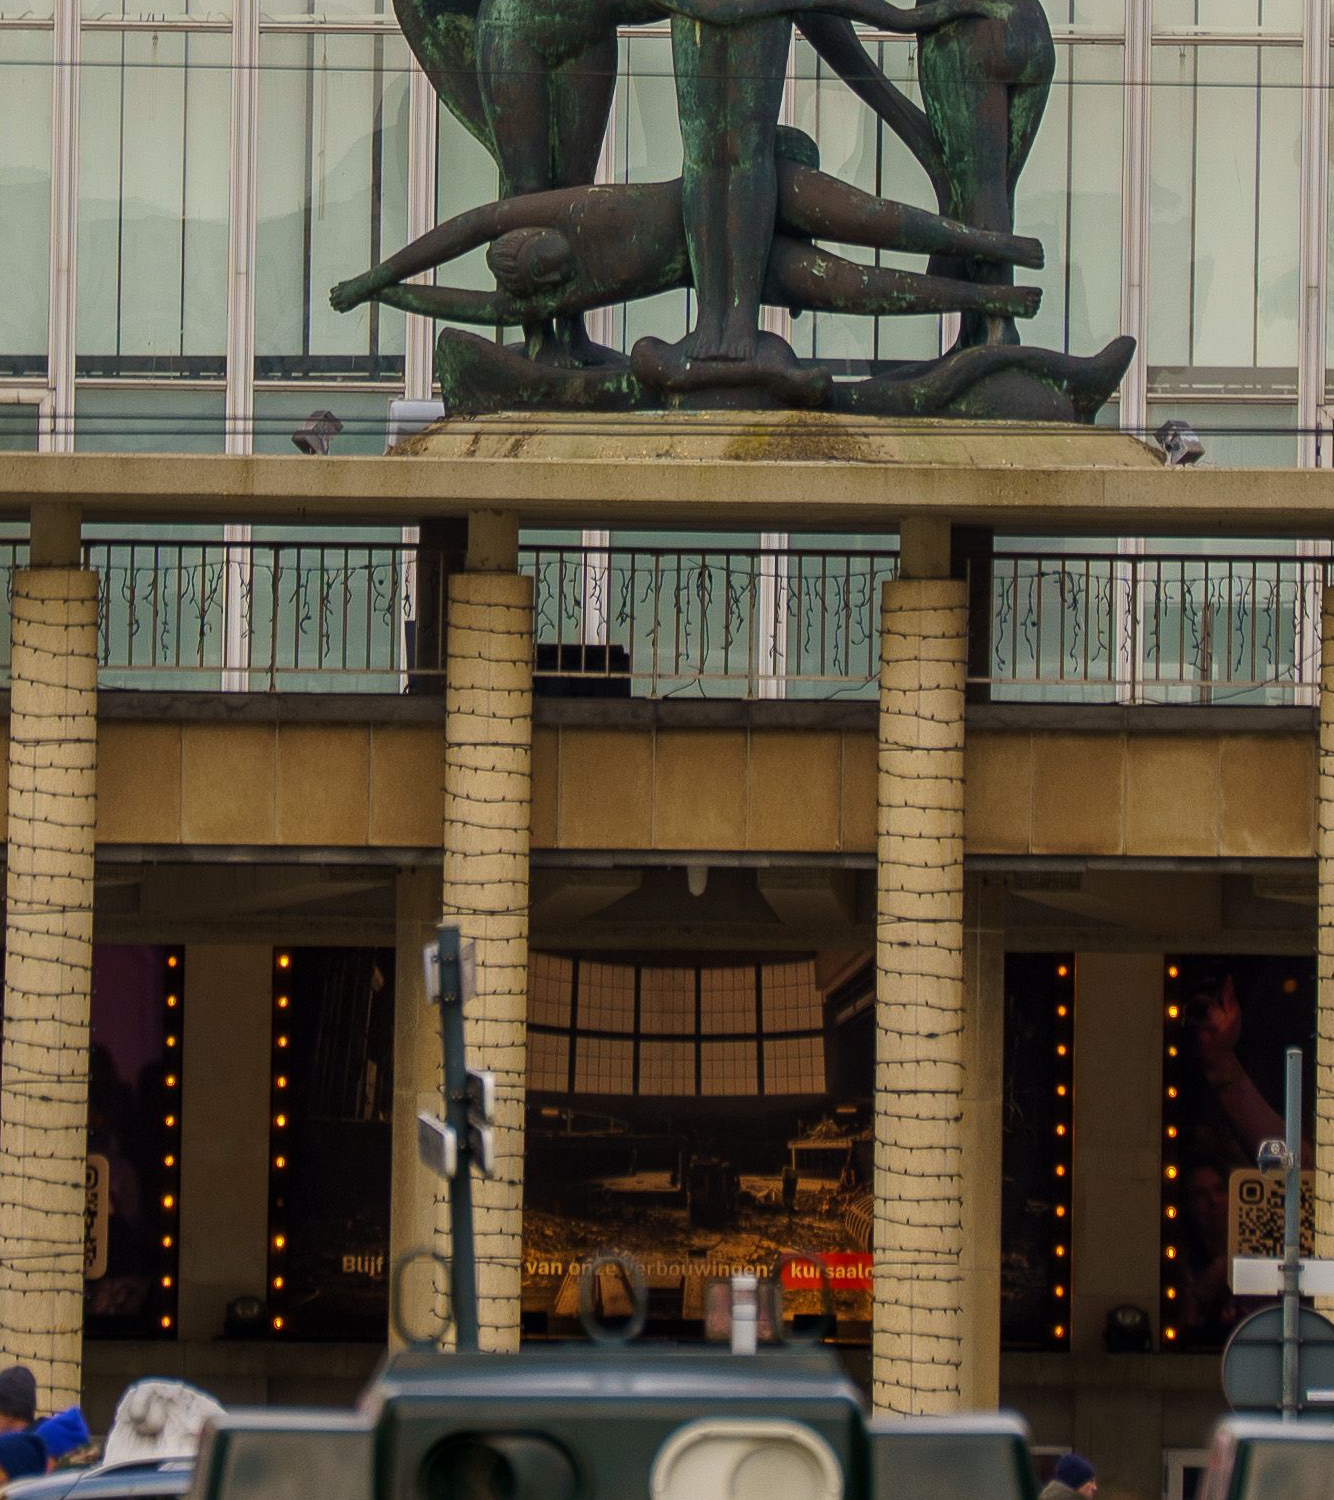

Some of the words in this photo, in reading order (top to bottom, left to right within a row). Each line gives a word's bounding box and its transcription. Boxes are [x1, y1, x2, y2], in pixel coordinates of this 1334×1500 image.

[341, 1256, 385, 1279] Blijf
[526, 1261, 563, 1276] van
[791, 1261, 874, 1279] kursaalo
